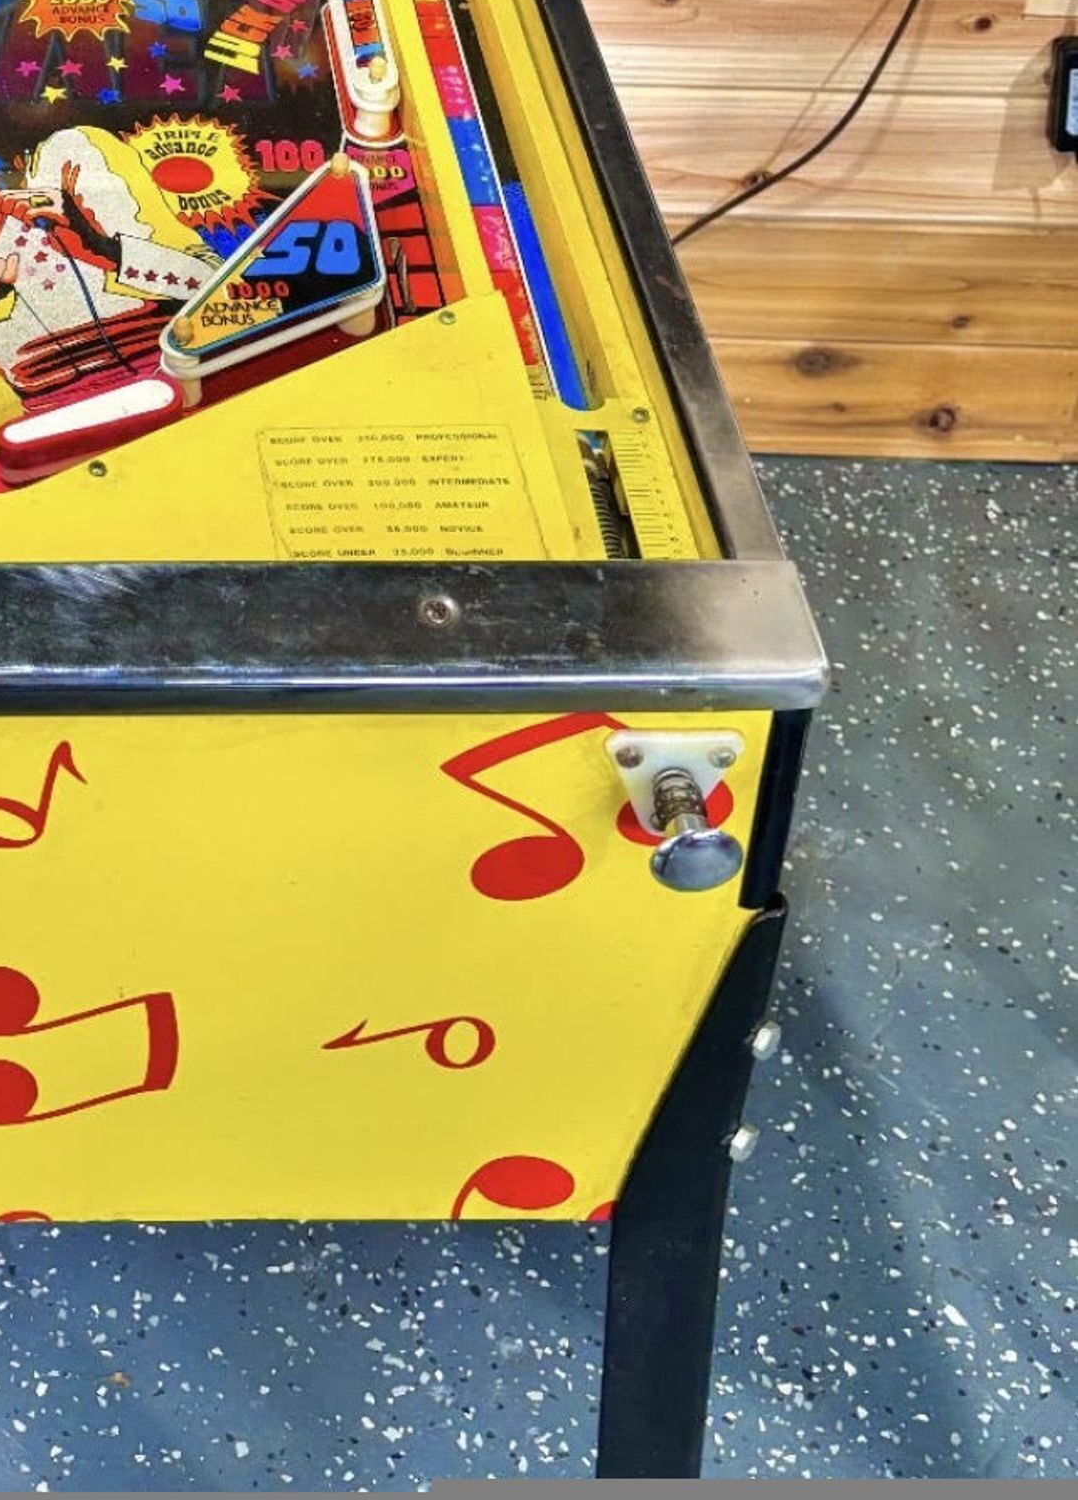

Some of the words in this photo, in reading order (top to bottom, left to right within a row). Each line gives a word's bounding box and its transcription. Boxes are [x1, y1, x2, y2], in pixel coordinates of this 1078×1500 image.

[254, 139, 325, 173] 100
[243, 221, 361, 276] 50
[225, 280, 290, 299] 1000
[202, 301, 280, 315] ADVANCE
[201, 312, 255, 327] BONUS
[428, 477, 510, 485] INTERMEDIATE
[434, 501, 490, 509] AMATEUR
[439, 525, 483, 533] NOVICE
